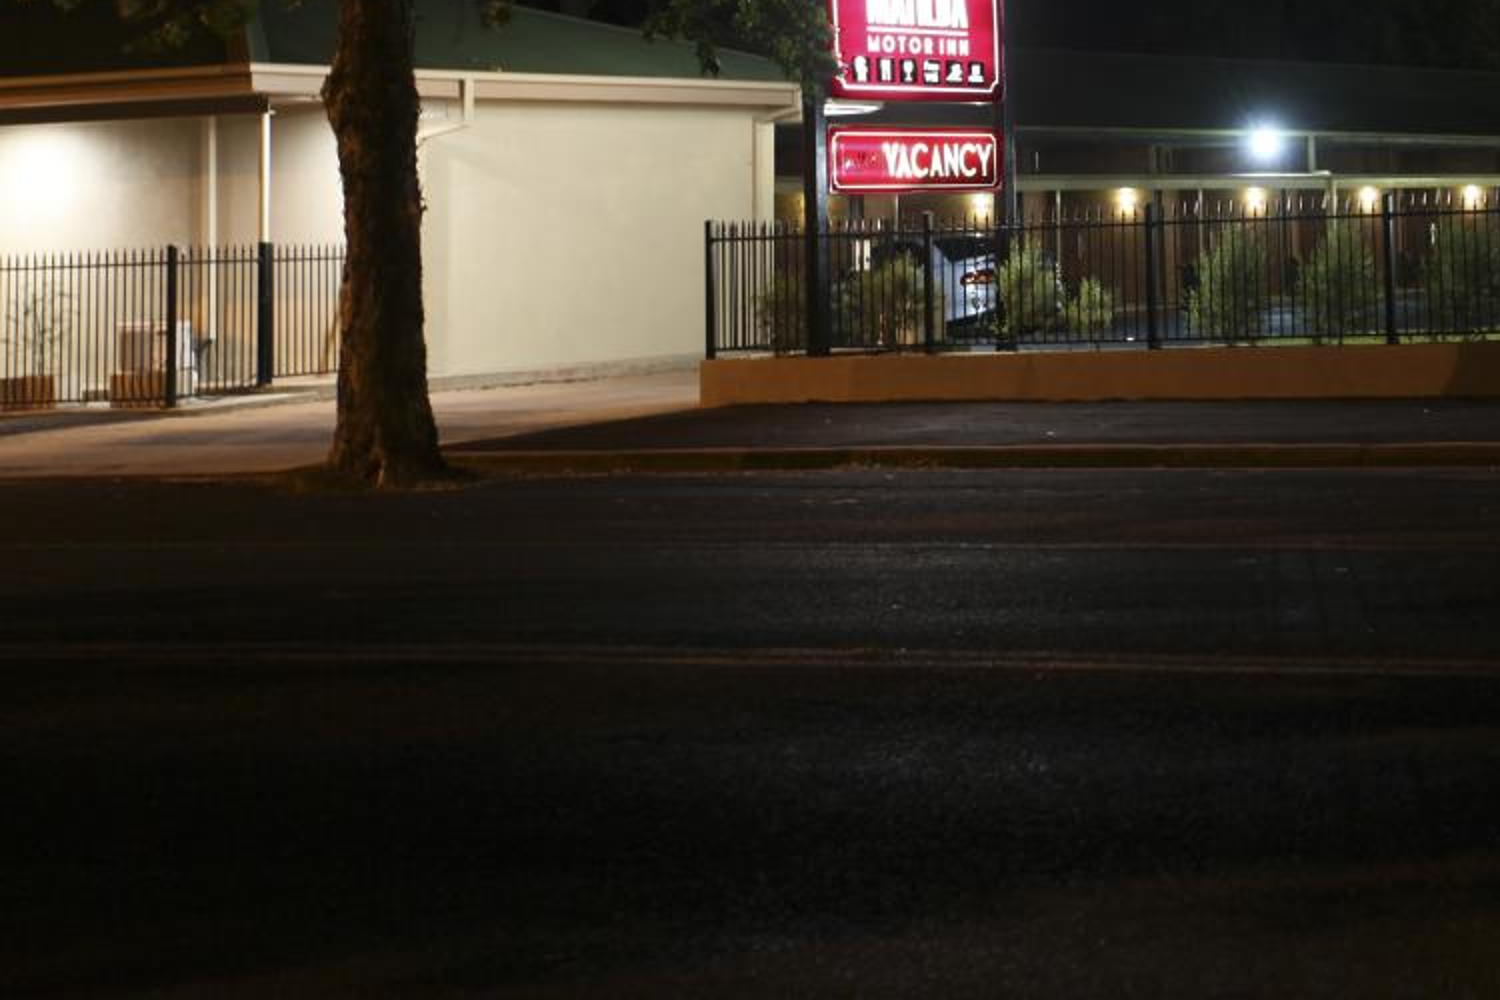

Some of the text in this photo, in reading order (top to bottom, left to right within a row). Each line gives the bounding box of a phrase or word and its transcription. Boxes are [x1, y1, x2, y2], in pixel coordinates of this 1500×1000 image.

[867, 35, 970, 57] MOTOR INN
[881, 142, 992, 178] VACANCY
